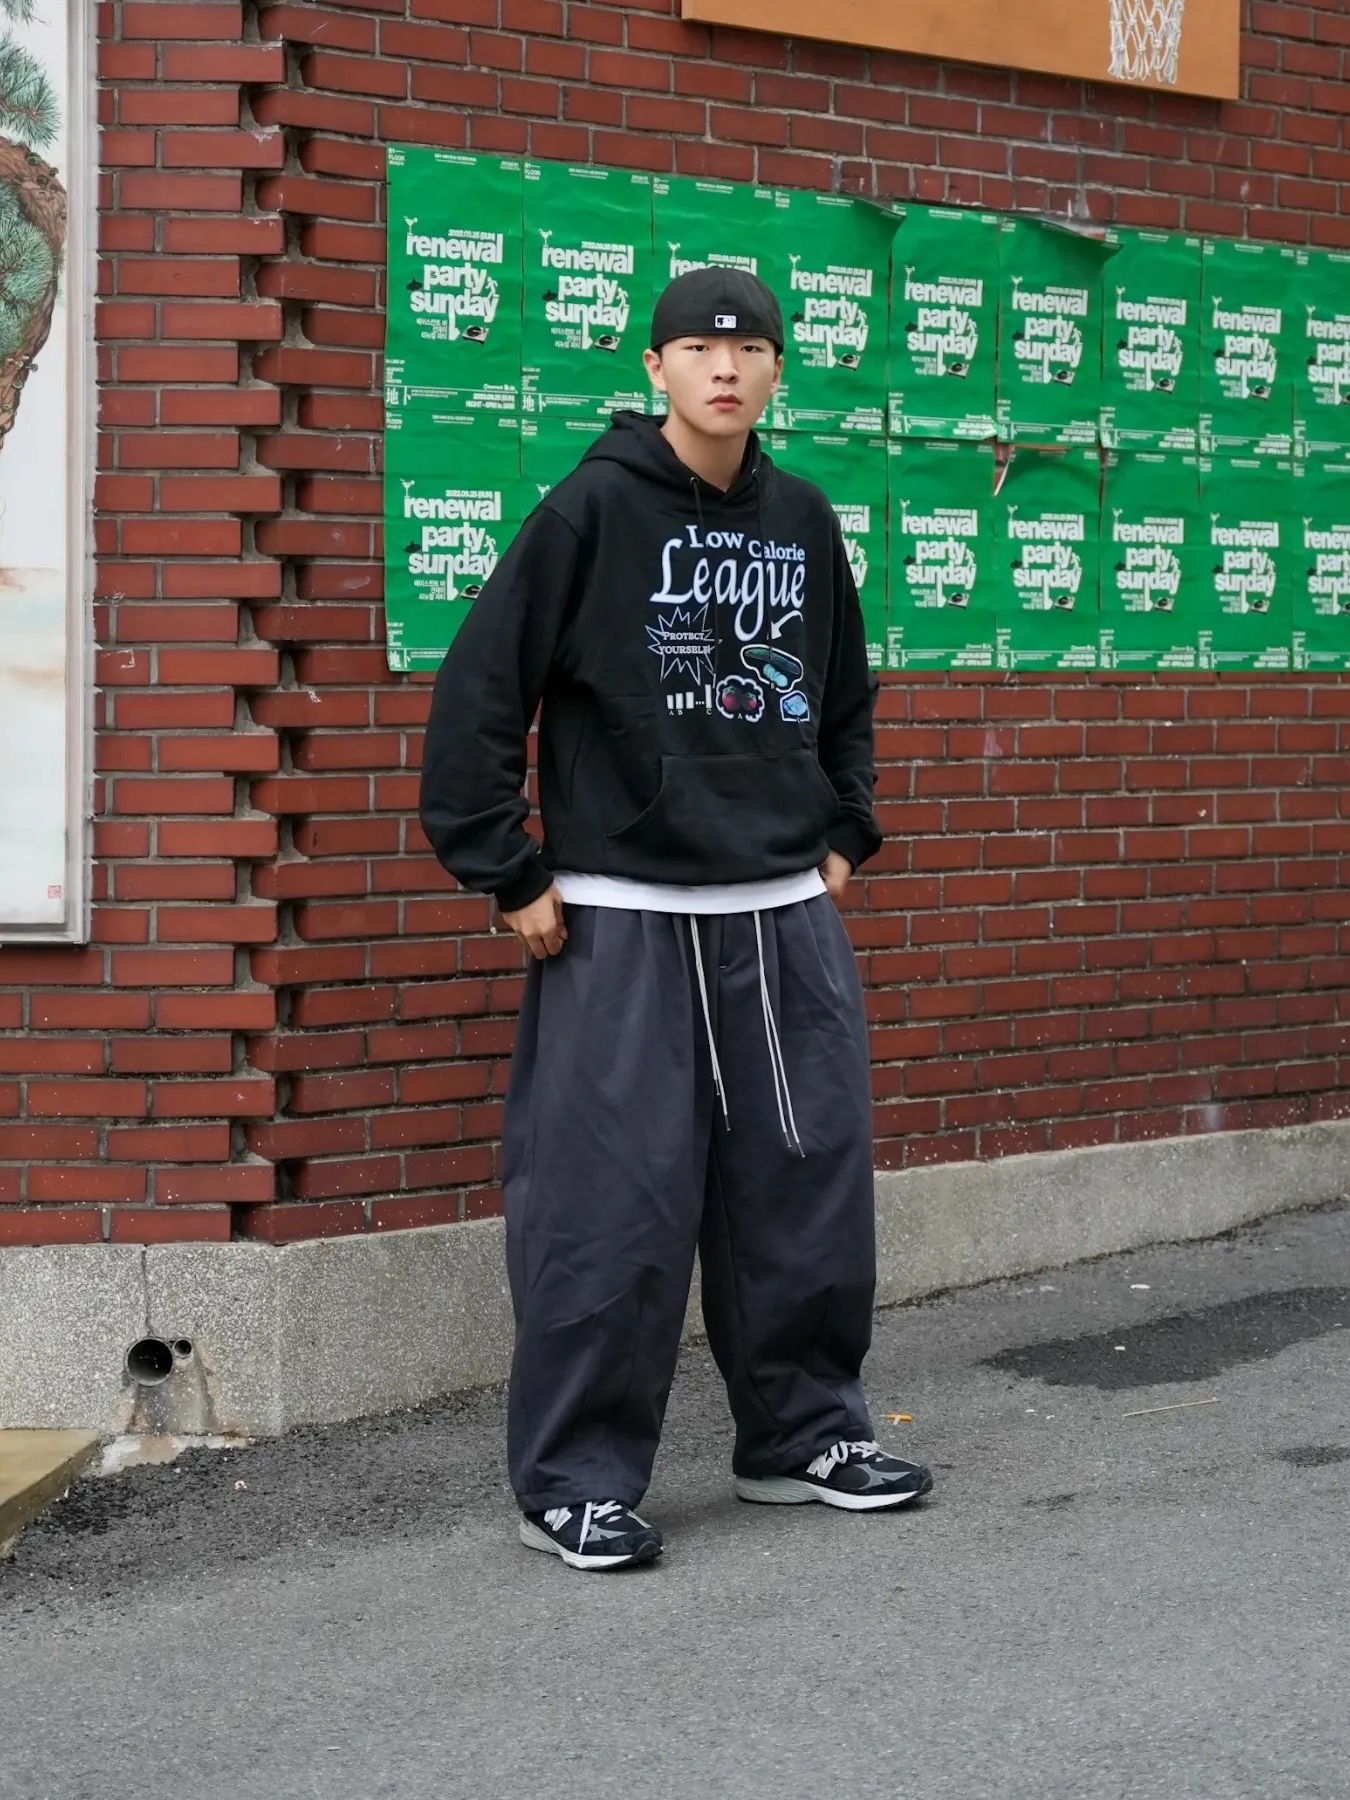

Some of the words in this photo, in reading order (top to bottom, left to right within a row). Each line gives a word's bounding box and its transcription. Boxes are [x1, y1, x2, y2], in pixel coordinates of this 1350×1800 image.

[406, 233, 503, 263] renewal
[542, 244, 634, 274] renewal
[423, 262, 487, 293] party
[558, 273, 618, 304] party
[791, 269, 873, 297] renewal
[409, 289, 499, 323] sunday
[905, 279, 983, 307] renewal
[1012, 290, 1088, 316] renewal
[545, 299, 630, 333] sunday
[804, 296, 858, 325] party
[917, 305, 969, 334] party
[1116, 300, 1187, 325] renewal
[1212, 309, 1282, 334] renewal
[793, 320, 868, 351] sunday
[1024, 315, 1074, 343] party
[1128, 324, 1175, 351] party
[907, 329, 978, 360] sunday
[1014, 338, 1083, 368] sunday
[1224, 333, 1270, 360] party
[1317, 341, 1350, 366] part
[1118, 347, 1183, 376] sunday
[1215, 356, 1277, 384] sunday
[404, 491, 501, 520] renewal
[901, 509, 977, 536] renewal
[1008, 514, 1085, 541] renewal
[1113, 518, 1184, 544] renewal
[1211, 522, 1279, 548] renewal
[422, 521, 486, 553] party
[686, 524, 745, 549] Low
[748, 540, 805, 561] Calorie
[915, 537, 966, 565] party
[408, 548, 498, 581] sunday
[1022, 541, 1072, 569] party
[1126, 544, 1172, 571] party
[1223, 548, 1268, 574] party
[1316, 551, 1350, 576] part
[905, 560, 977, 590] sunday
[1013, 564, 1082, 593] sunday
[1117, 567, 1181, 595] sunday
[1214, 570, 1276, 597] sunday
[649, 538, 805, 641] League
[663, 632, 705, 641] PROTECT
